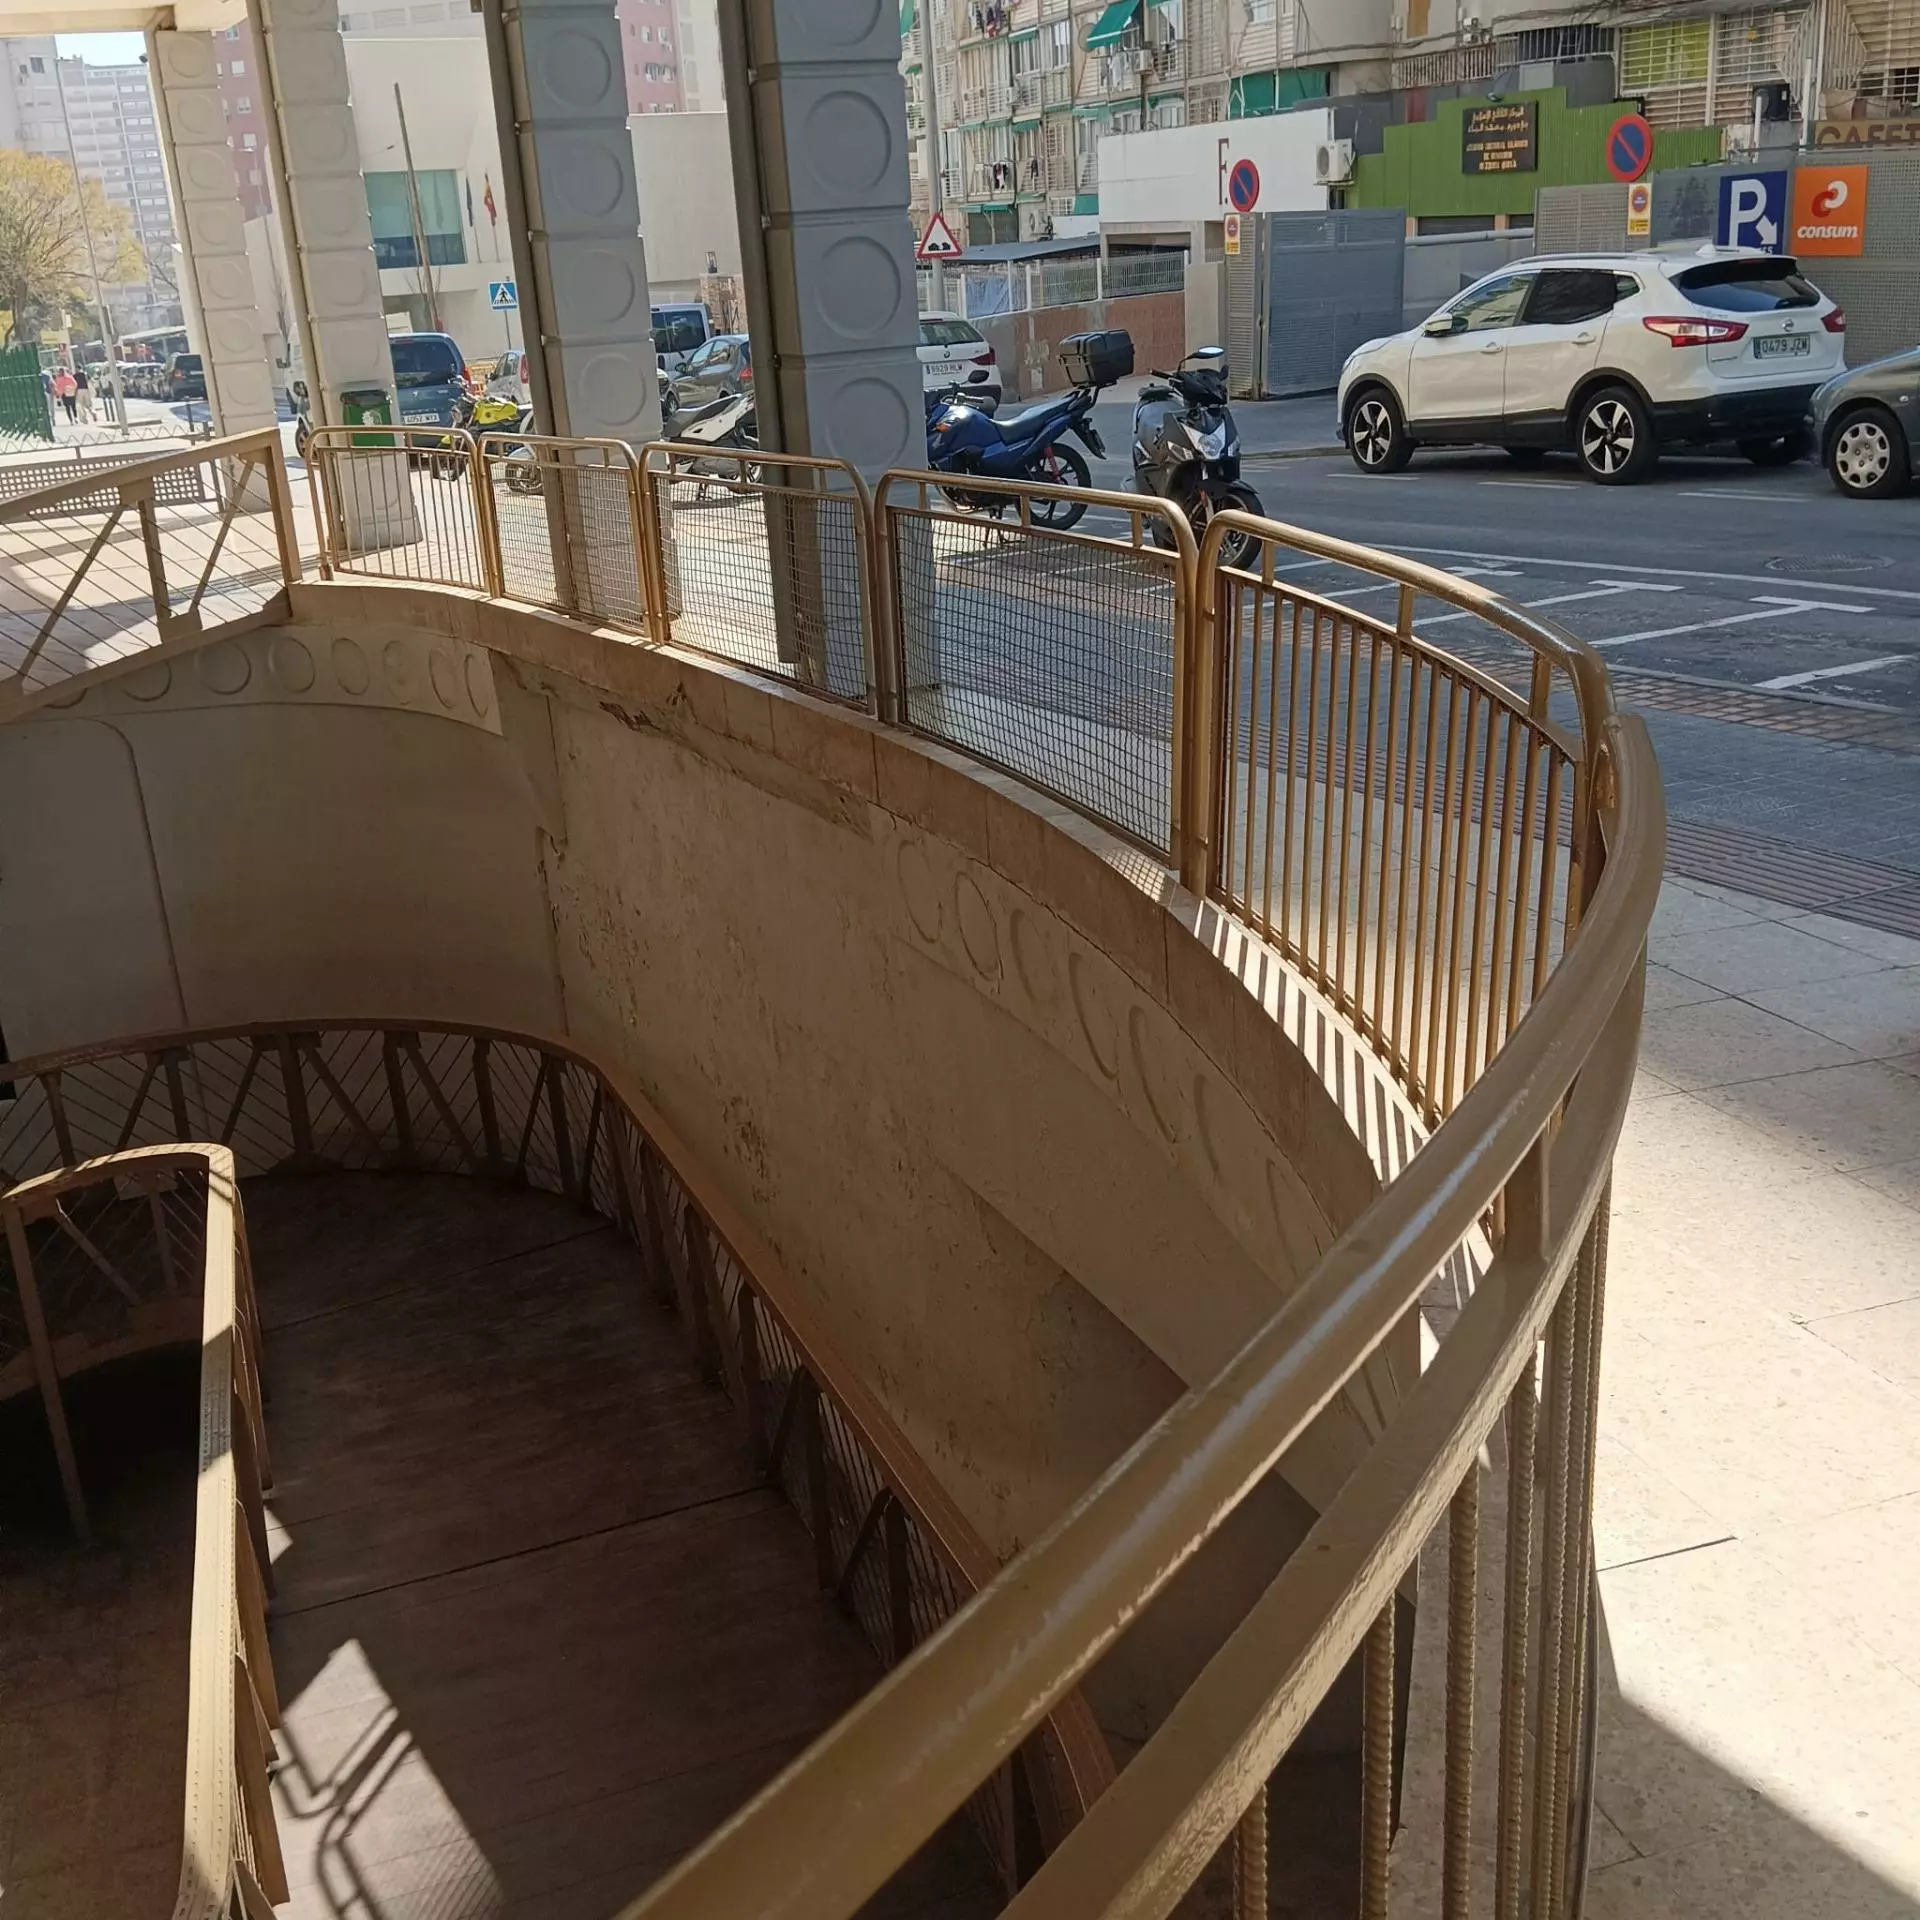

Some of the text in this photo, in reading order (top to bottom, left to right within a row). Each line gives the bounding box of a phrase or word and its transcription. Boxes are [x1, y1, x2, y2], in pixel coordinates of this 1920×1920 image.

[1729, 179, 1767, 249] P
[1797, 226, 1858, 238] consum
[1762, 340, 1788, 353] 0479
